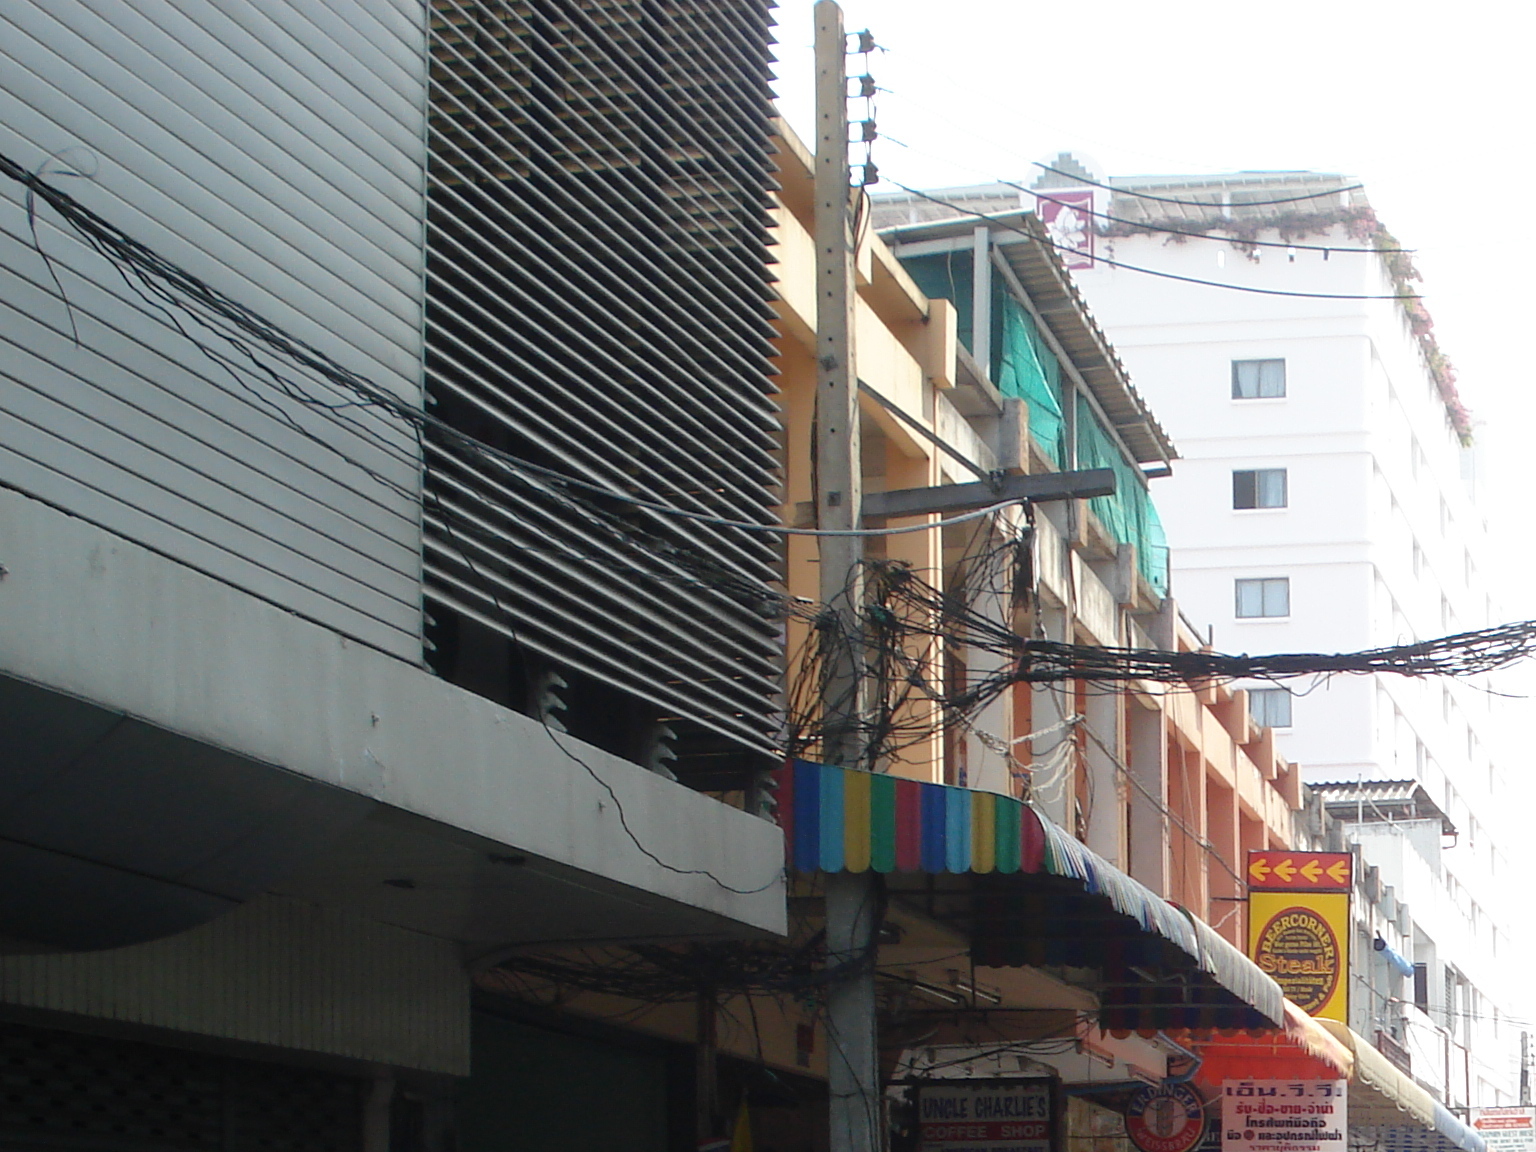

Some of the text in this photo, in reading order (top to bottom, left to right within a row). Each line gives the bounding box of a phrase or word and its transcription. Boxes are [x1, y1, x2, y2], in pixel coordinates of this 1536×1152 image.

[1259, 953, 1334, 975] Steak
[923, 1095, 1046, 1119] UNCLE CHARLIE'S
[924, 1124, 1045, 1139] COFFEE SHOP
